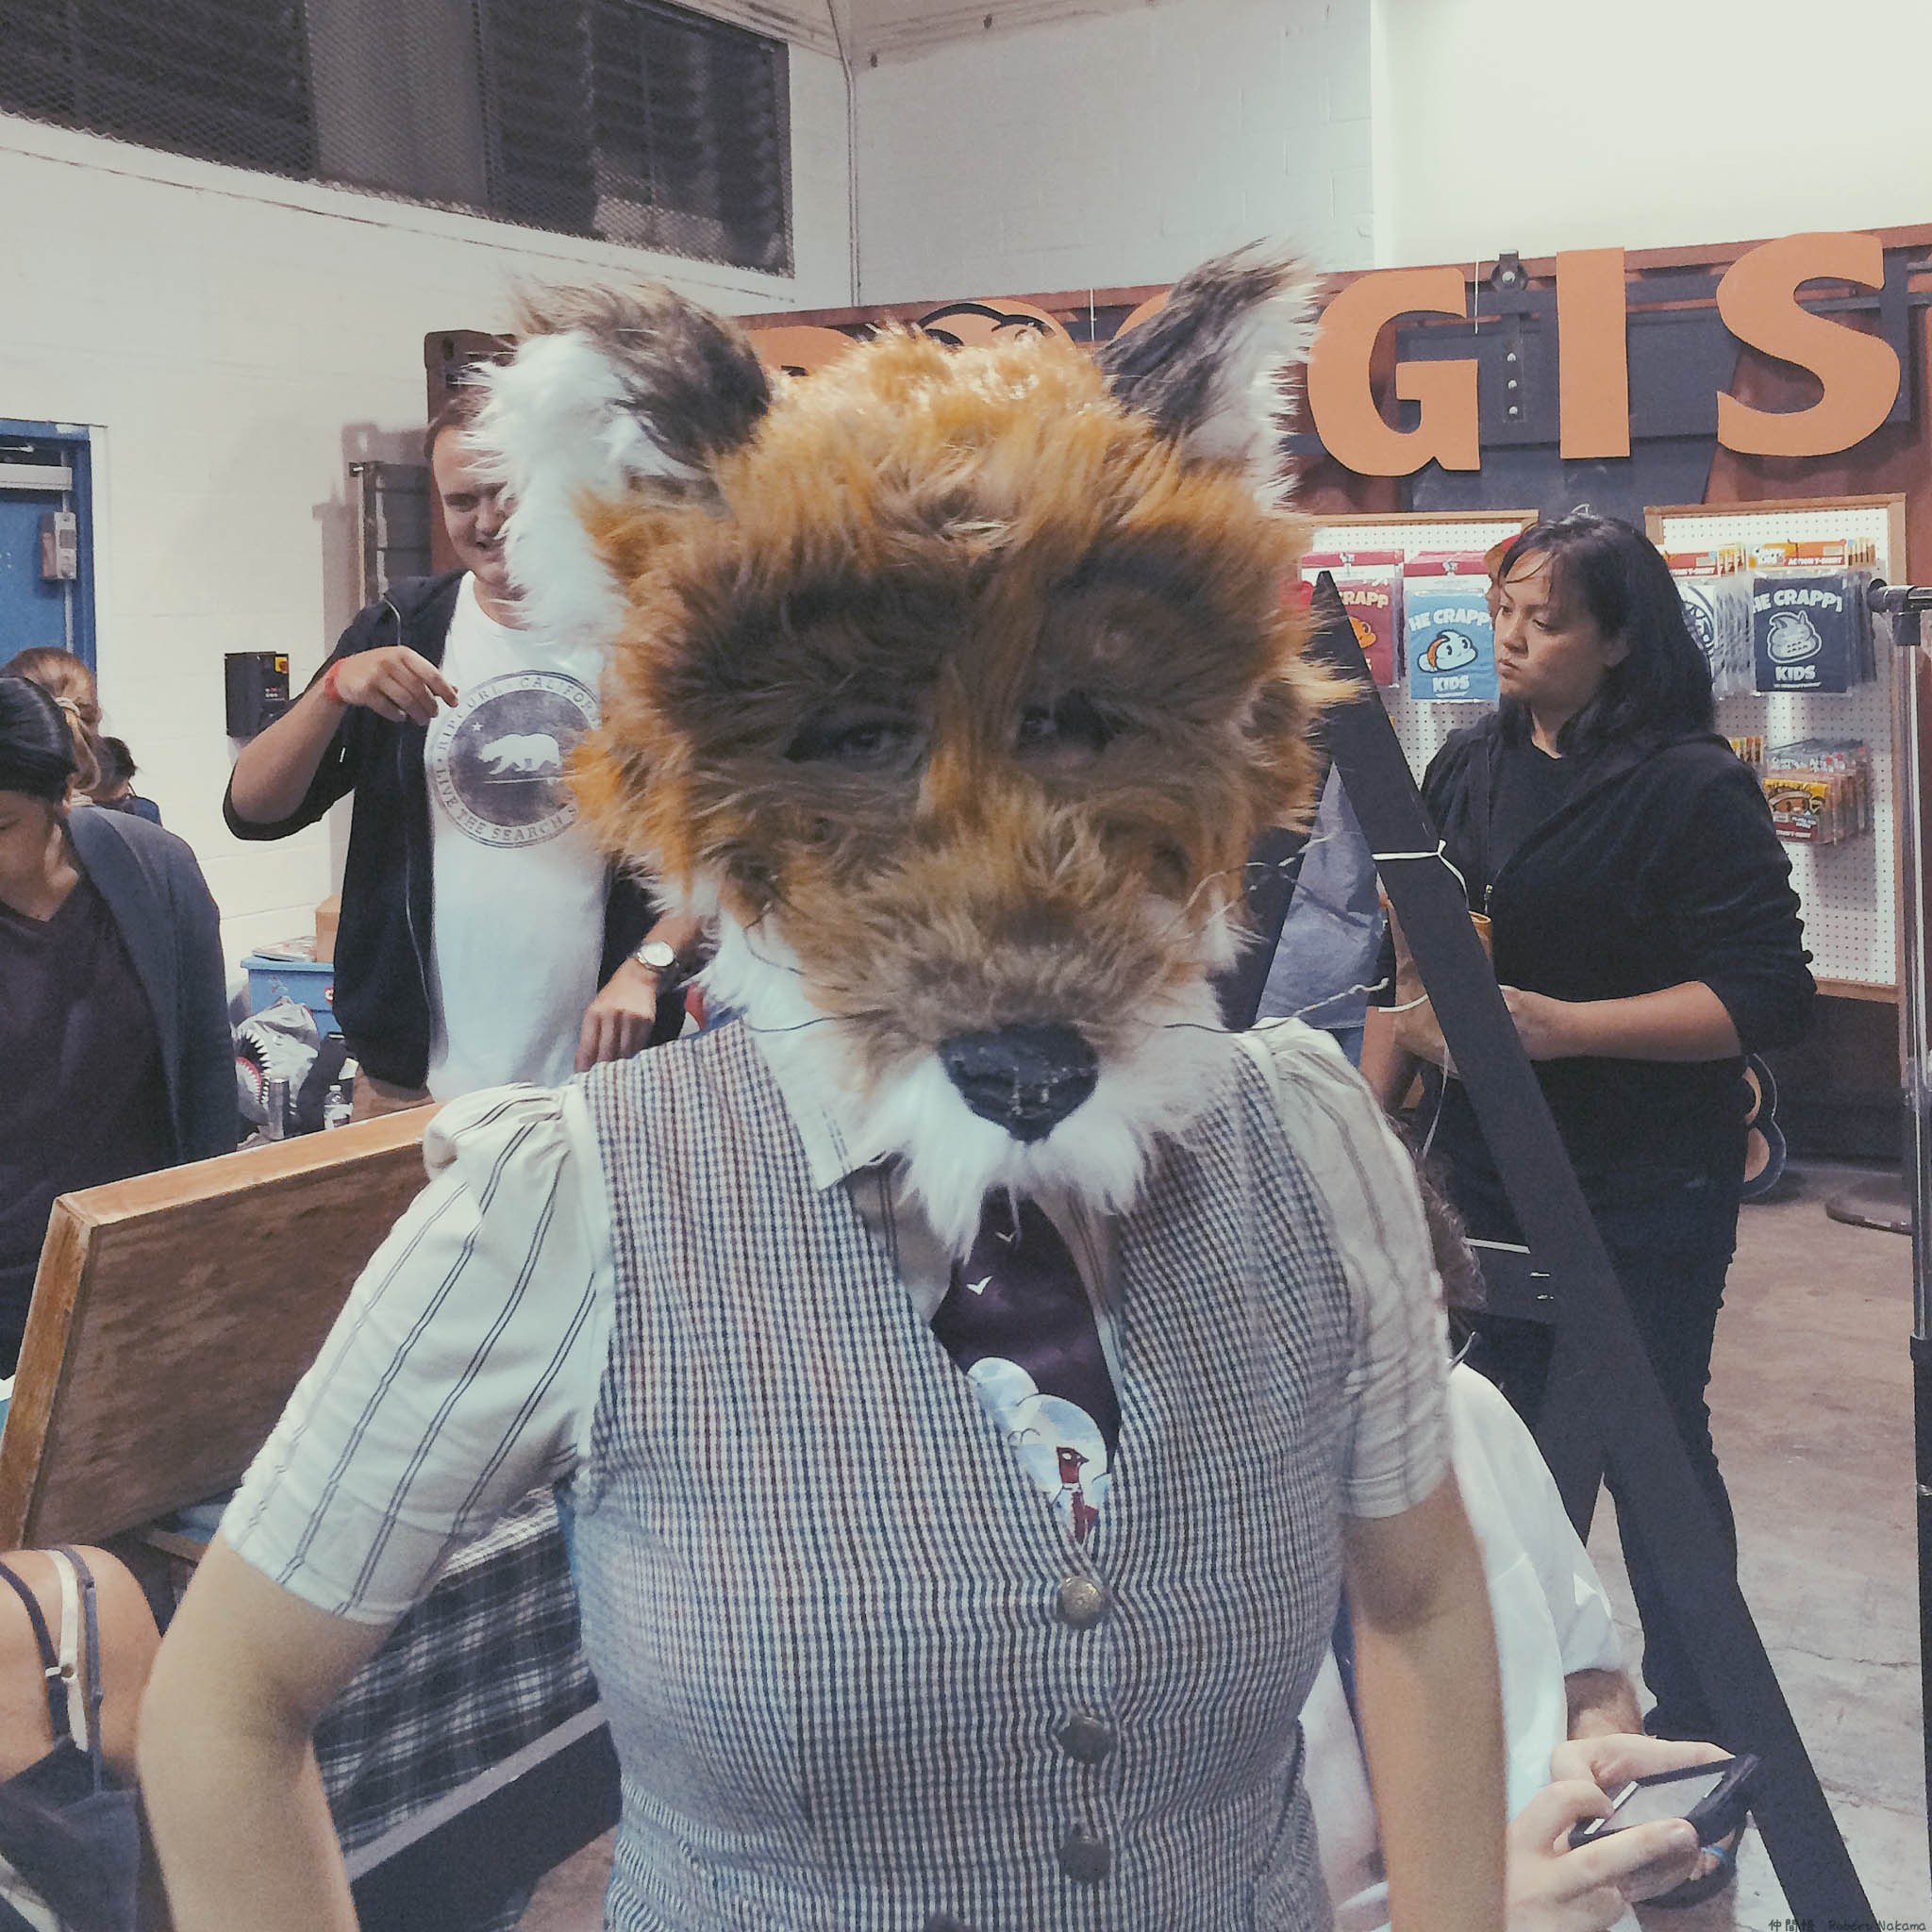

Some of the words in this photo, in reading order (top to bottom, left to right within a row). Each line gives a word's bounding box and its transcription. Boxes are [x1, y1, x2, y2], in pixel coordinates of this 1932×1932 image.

[1113, 231, 1901, 476] GIS
[1339, 591, 1389, 608] RAPP
[1753, 593, 1772, 613] HE
[1408, 611, 1432, 631] HE
[1434, 608, 1492, 630] CRAPP
[1432, 675, 1470, 691] KIDS
[1774, 665, 1816, 681] KIDS
[436, 768, 458, 806] LIVE
[491, 813, 564, 841] SEARCH
